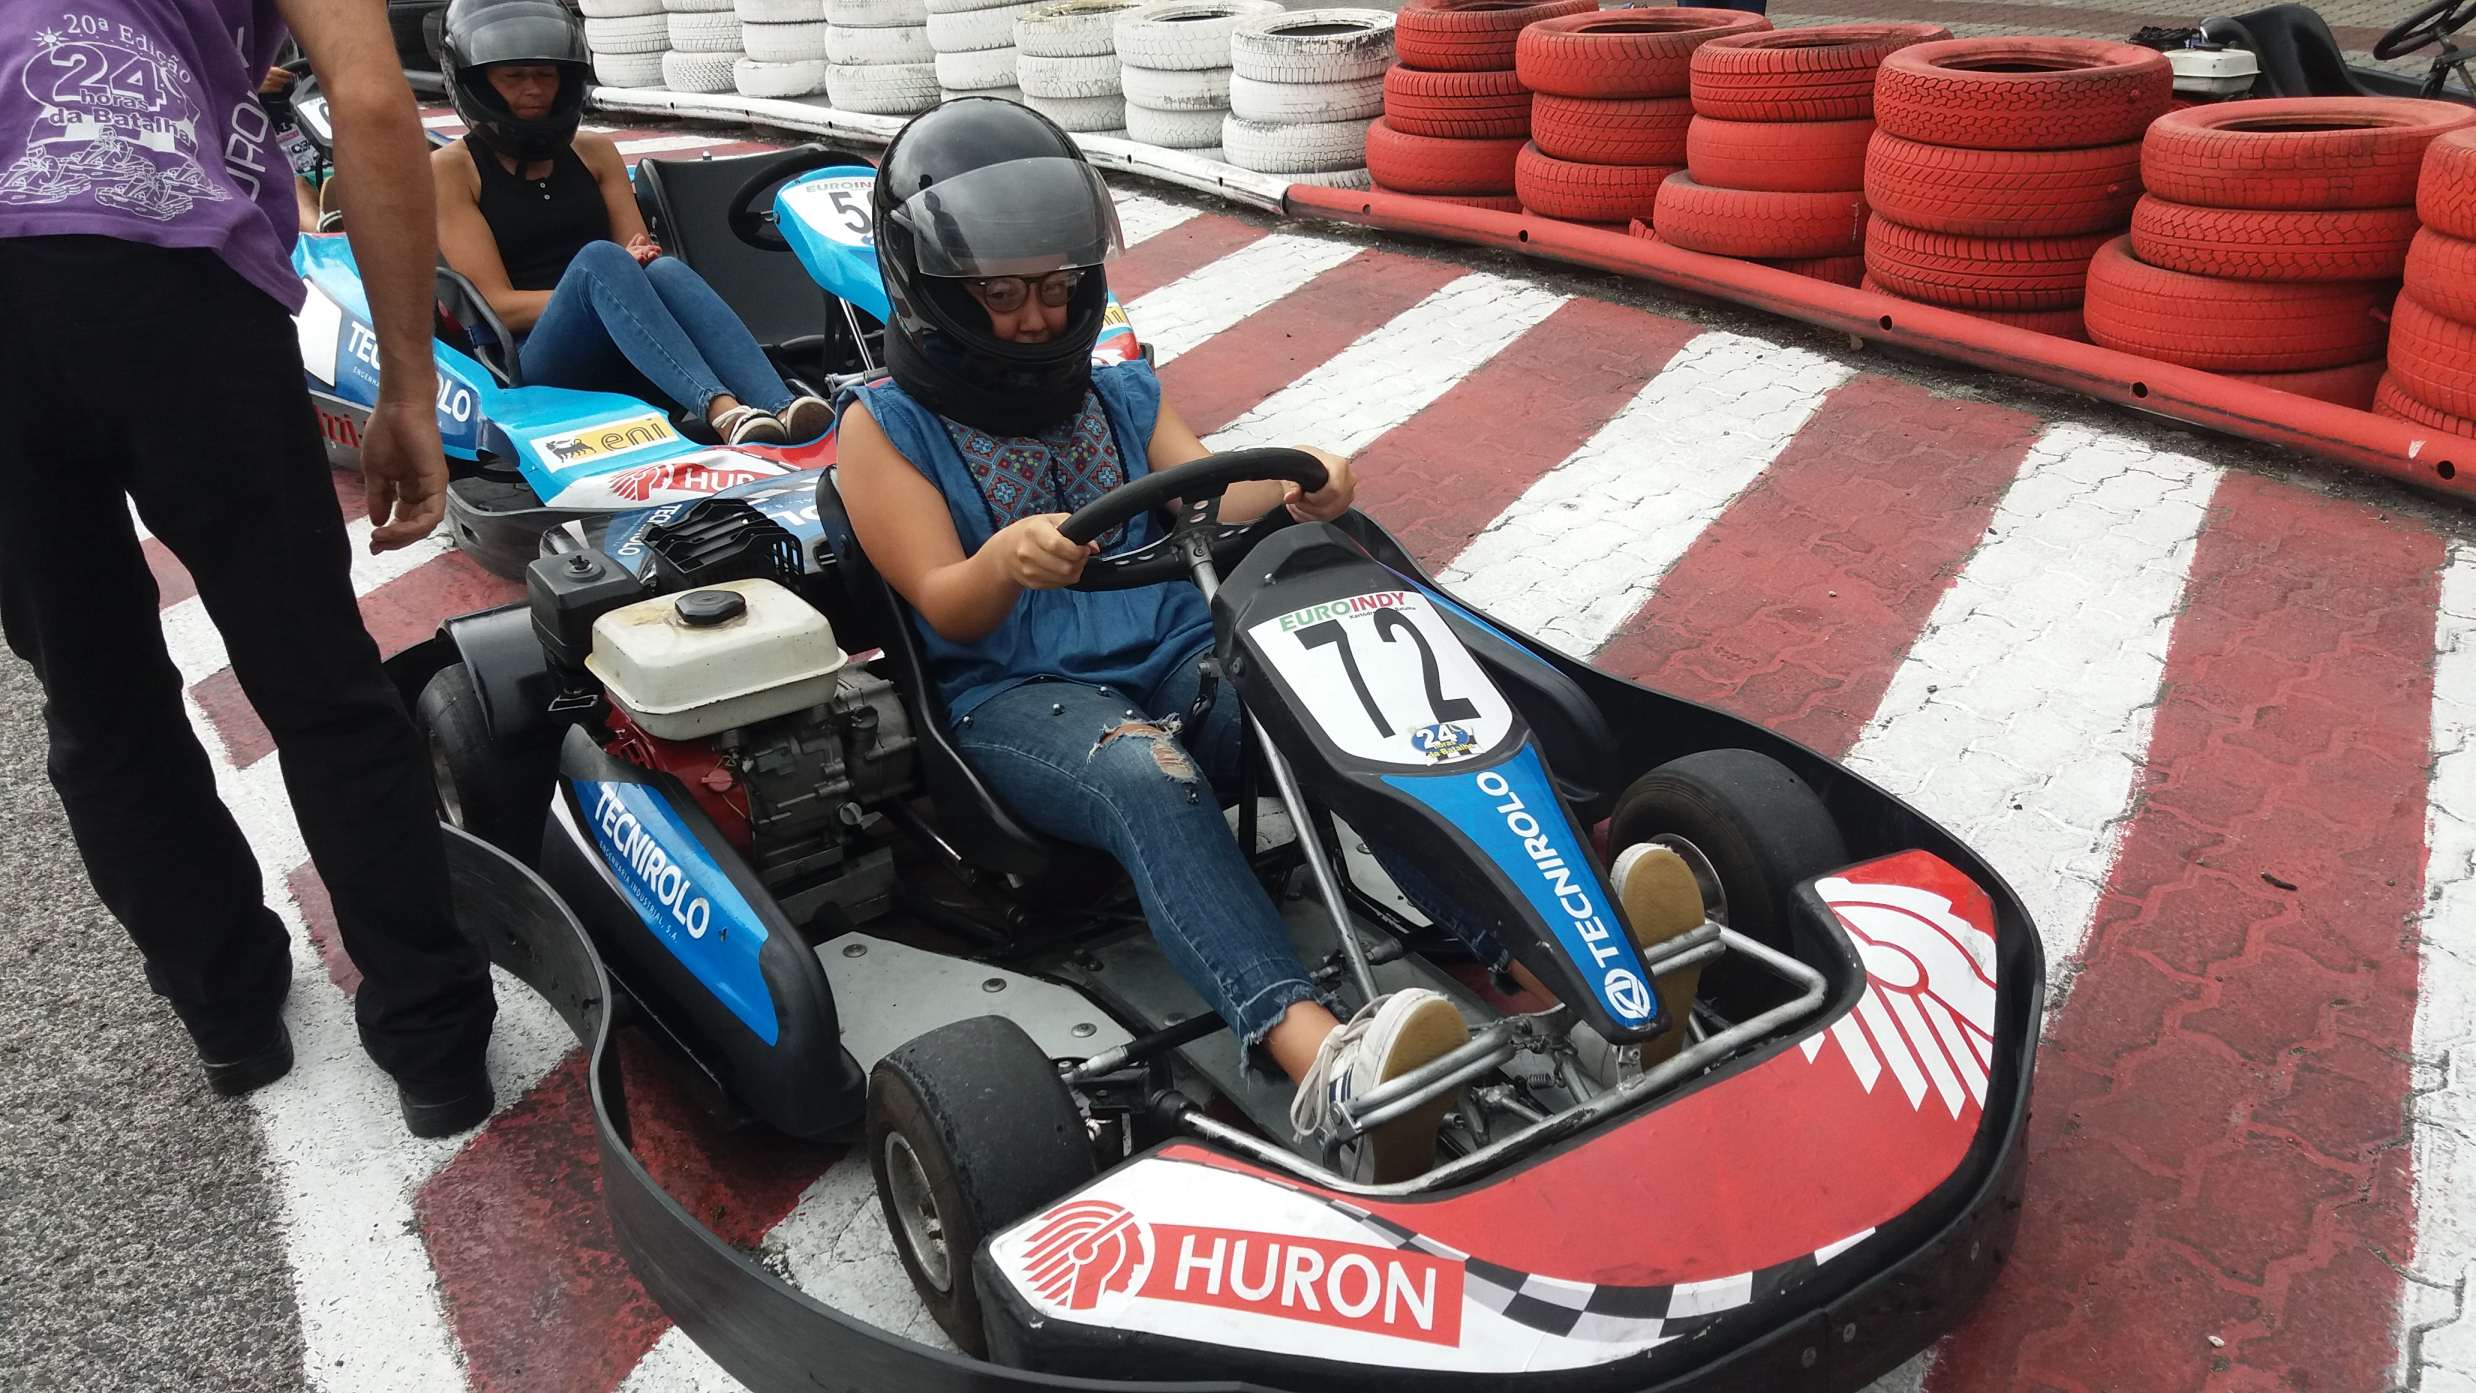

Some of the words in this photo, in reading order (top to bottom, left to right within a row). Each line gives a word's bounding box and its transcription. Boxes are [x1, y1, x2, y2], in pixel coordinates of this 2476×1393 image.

[50, 41, 167, 112] 24
[118, 24, 191, 83] Edição
[80, 88, 150, 112] horas
[50, 106, 82, 126] da
[92, 106, 192, 147] Batalha
[806, 181, 875, 193] EUROIN
[601, 418, 667, 450] eni
[1279, 592, 1405, 632] EUROINDY
[1293, 607, 1482, 739] 72
[1416, 724, 1457, 750] 24
[594, 782, 709, 939] TECNIROLO
[1476, 771, 1619, 969] TECNIROLO
[1174, 1233, 1437, 1331] HURON
